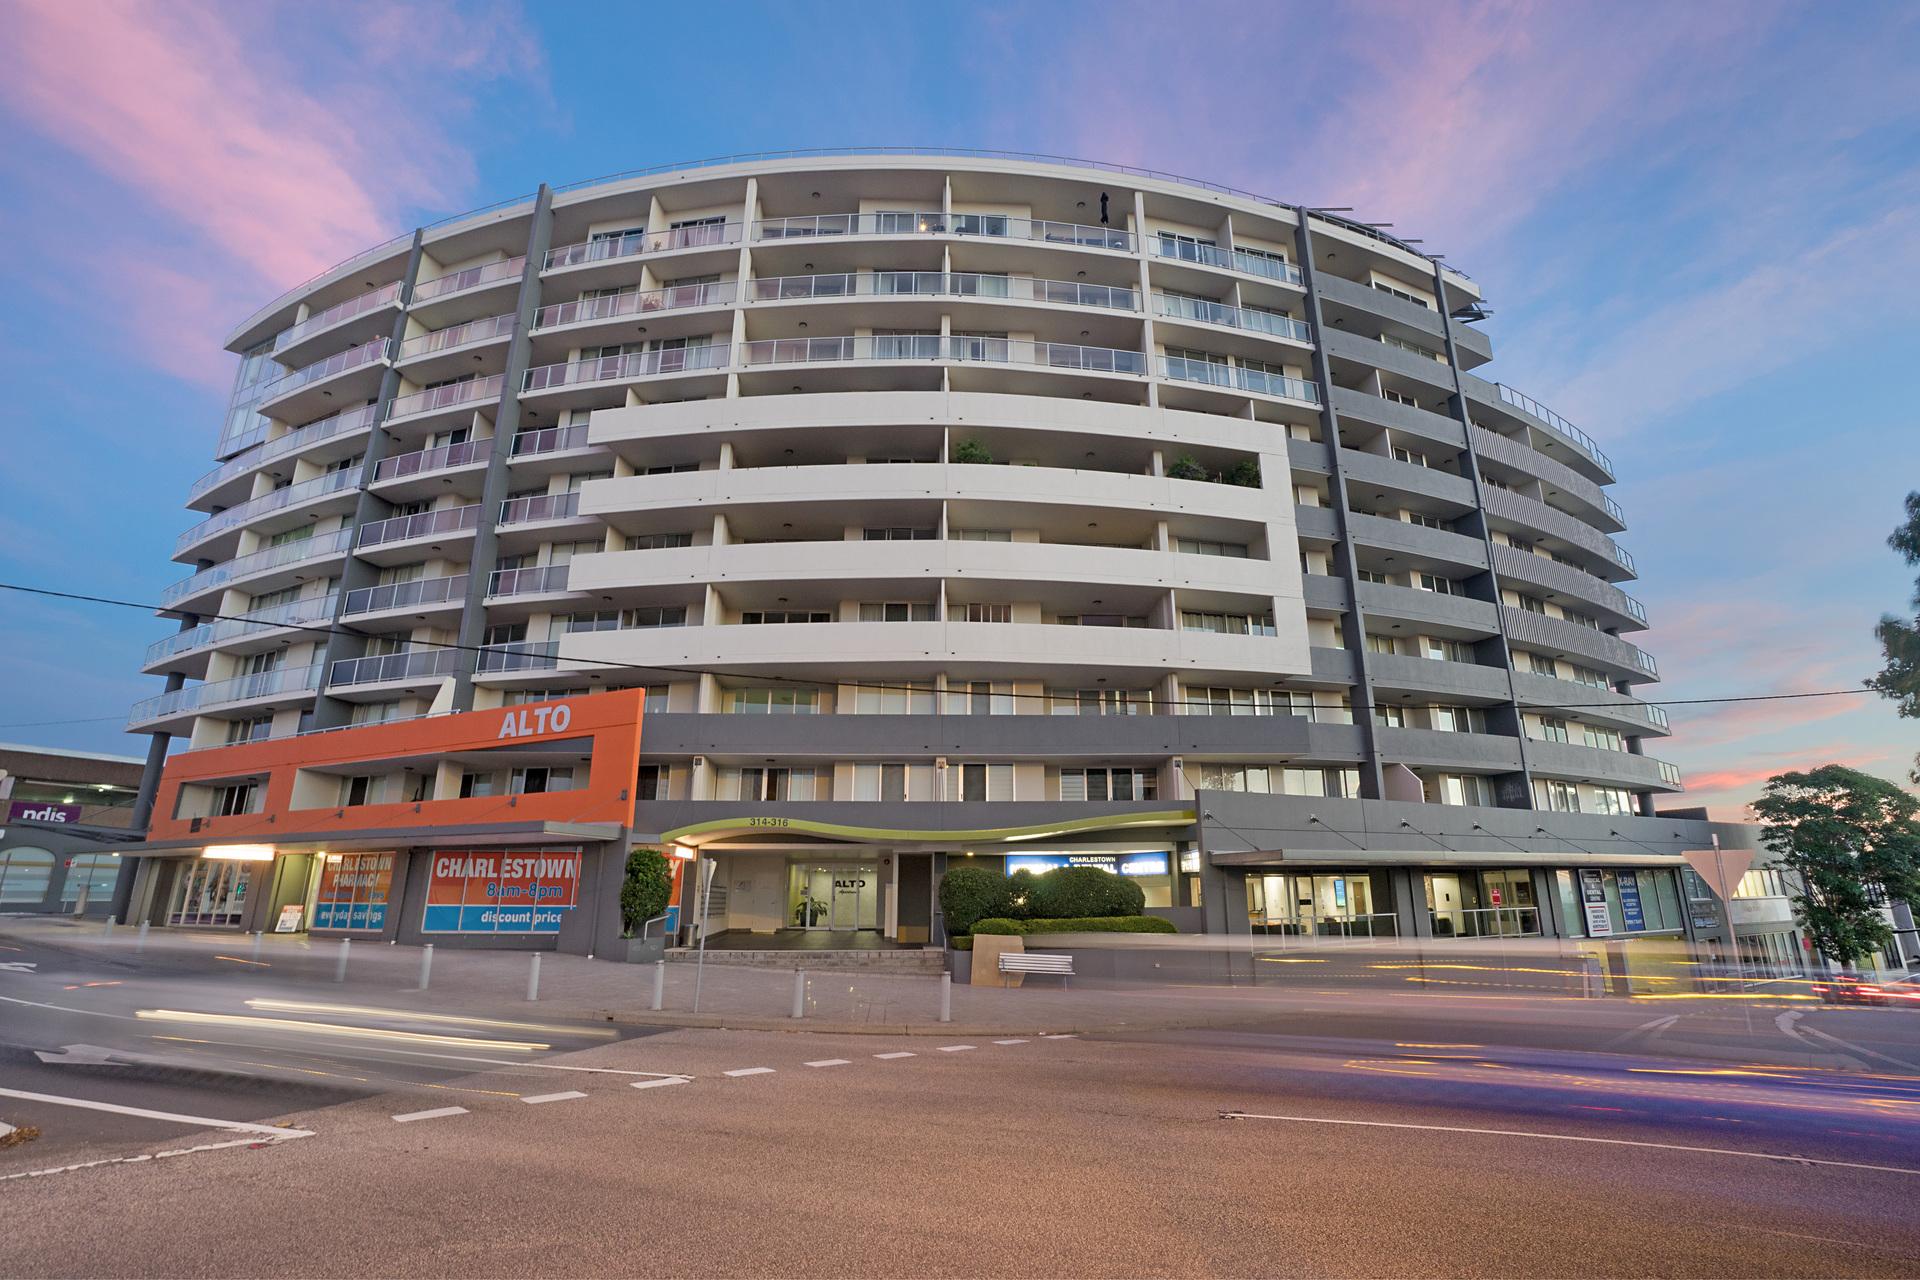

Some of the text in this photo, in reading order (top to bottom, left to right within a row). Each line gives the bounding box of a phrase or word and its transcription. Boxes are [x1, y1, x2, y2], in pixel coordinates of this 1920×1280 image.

[498, 704, 571, 739] ALTO
[22, 807, 67, 823] ndis
[750, 817, 789, 827] 314-316
[437, 857, 581, 879] CHARLESTOWN
[487, 882, 562, 902] 8am-8pm
[835, 880, 866, 888] ALTO
[481, 911, 530, 924] discount
